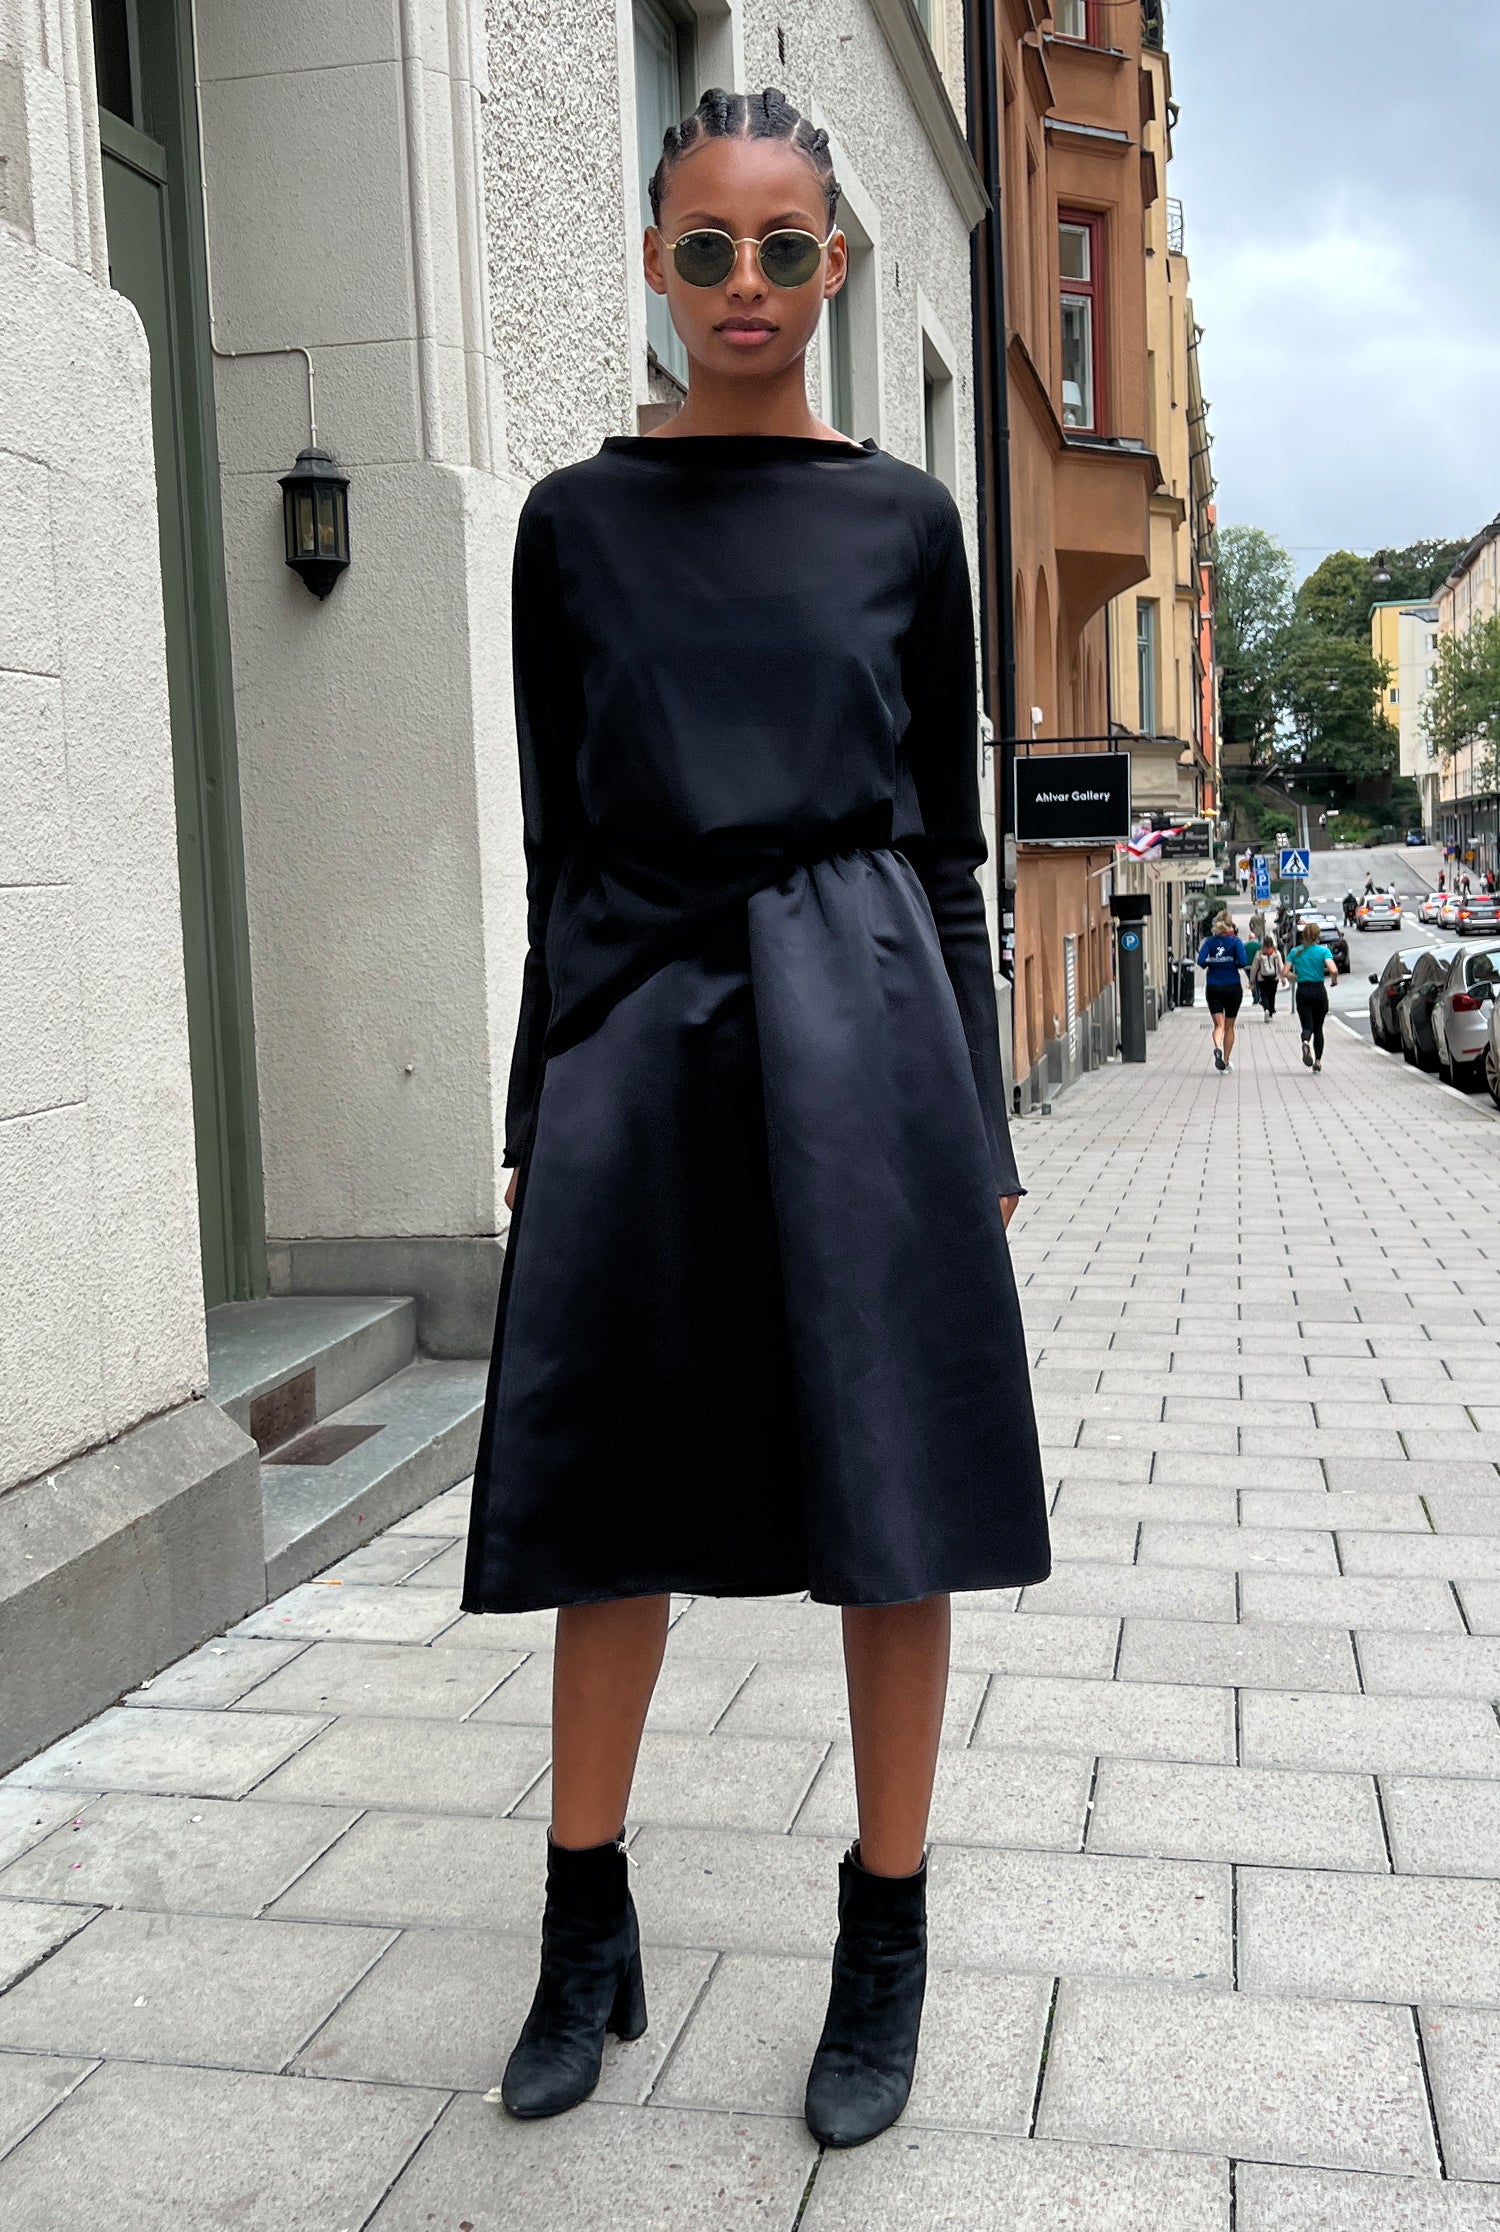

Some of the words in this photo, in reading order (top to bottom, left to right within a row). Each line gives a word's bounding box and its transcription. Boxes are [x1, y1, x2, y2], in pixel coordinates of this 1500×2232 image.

[1035, 791, 1070, 803] Ahlvar
[1071, 790, 1110, 803] Gallery
[1126, 935, 1136, 948] P
